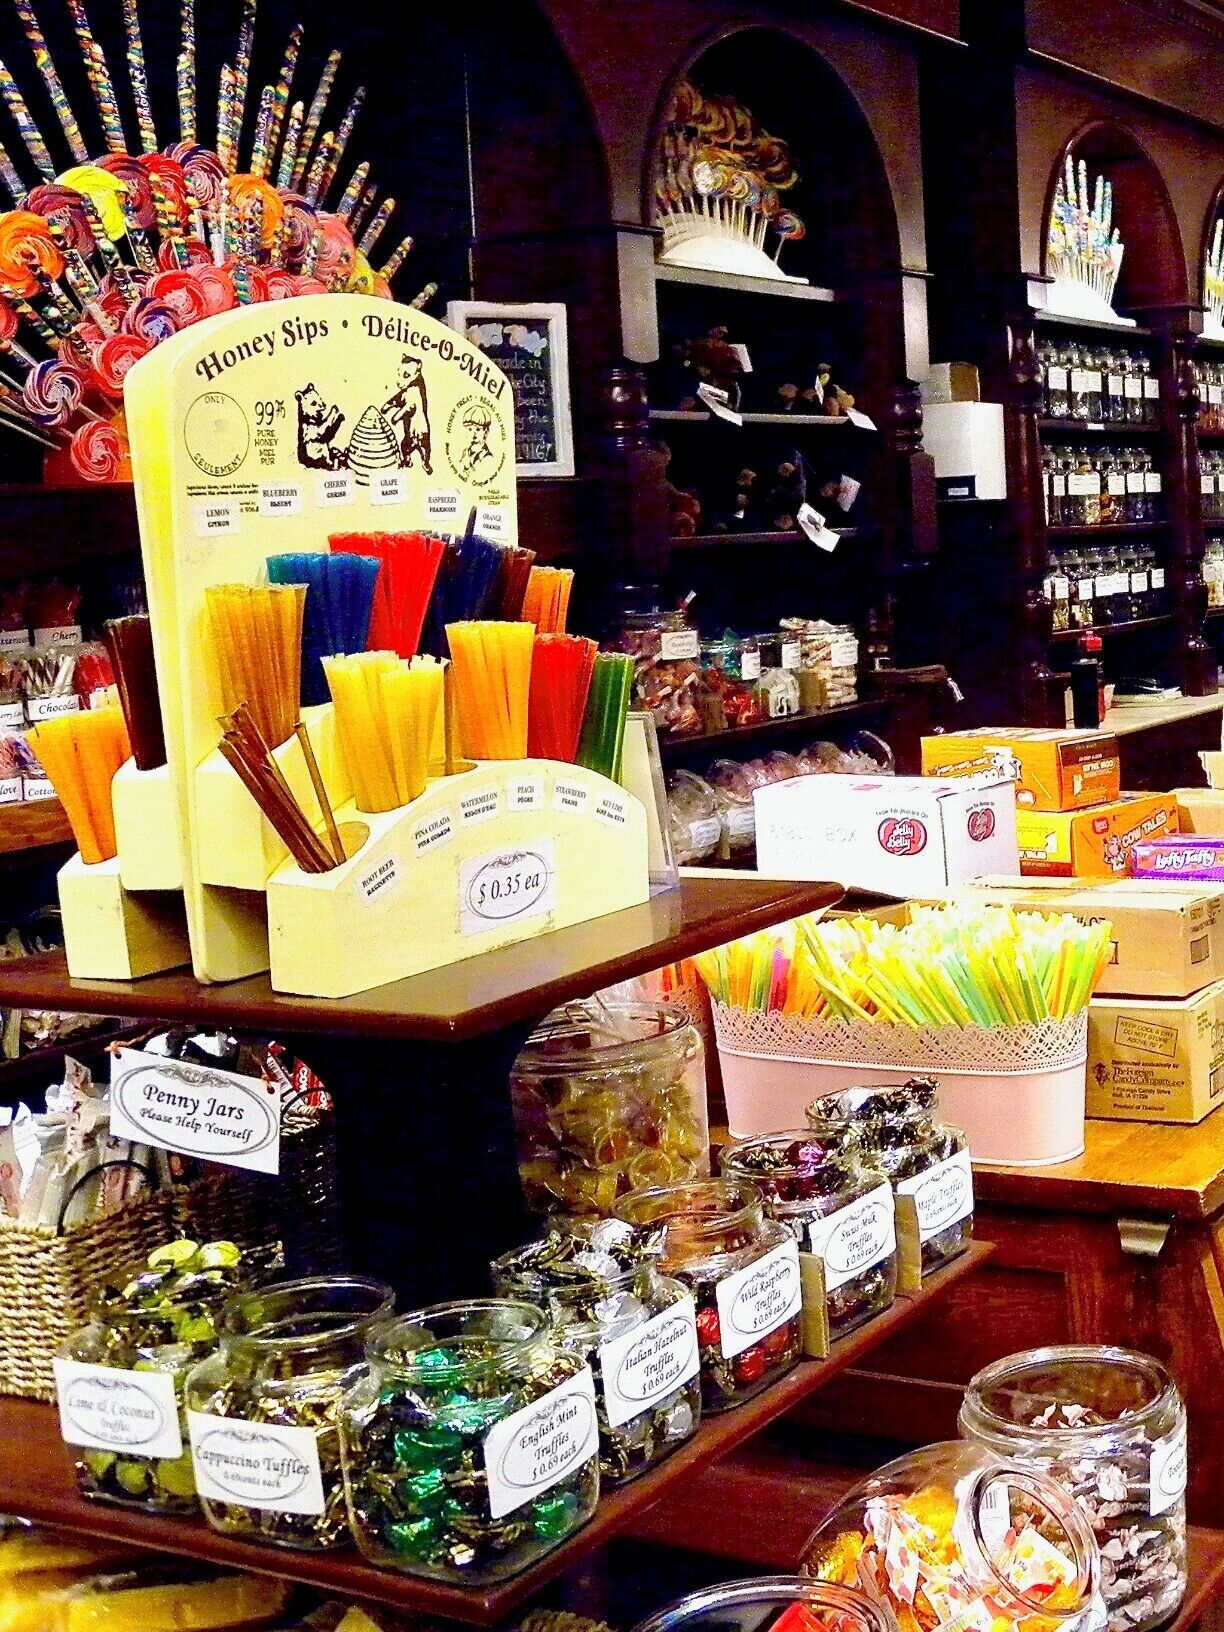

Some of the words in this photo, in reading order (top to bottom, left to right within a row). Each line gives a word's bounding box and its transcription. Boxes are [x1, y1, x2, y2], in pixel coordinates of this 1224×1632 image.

[195, 331, 276, 382] Honey
[282, 316, 330, 348] Sips
[361, 314, 506, 400] Délice-O-Miel
[204, 395, 226, 405] ONLY
[194, 452, 242, 474] SEULEMENT
[261, 457, 275, 465] PUR
[262, 489, 298, 498] BLUEBERRY
[324, 480, 347, 489] CHERRY
[380, 479, 399, 487] GRAPE
[428, 496, 457, 504] RASPBERRY
[206, 508, 230, 518] LEMON
[461, 792, 498, 809] WATERMELON
[518, 786, 534, 794] PEACH
[556, 785, 586, 798] STRAWBERRY
[428, 816, 451, 833] COLADA
[893, 822, 915, 838] Jelly
[1122, 827, 1143, 848] COW
[1142, 810, 1168, 834] TALES
[887, 834, 911, 850] Belly
[1155, 850, 1187, 870] Laffy
[1183, 849, 1216, 868] Taffy
[362, 870, 378, 888] ROOT
[378, 859, 395, 875] BEER
[478, 883, 487, 905] $
[491, 873, 521, 900] 0.35
[524, 872, 540, 889] ea
[143, 1084, 200, 1117] Penny
[203, 1098, 245, 1120] Jars
[140, 1107, 173, 1124] Please
[175, 1114, 202, 1134] Help
[205, 1120, 254, 1144] Yourself
[840, 1223, 861, 1242] Swiss
[861, 1211, 878, 1231] Milk
[847, 1231, 873, 1252] Truffles
[851, 1249, 865, 1266] 0.69
[864, 1243, 878, 1260] each
[740, 1281, 760, 1304] Wild
[759, 1265, 791, 1293] Raspberry
[754, 1289, 782, 1313] Truffles
[758, 1309, 773, 1327] 0.69
[772, 1299, 788, 1317] each
[625, 1347, 653, 1371] Italian
[653, 1324, 688, 1356] Hazelnut
[643, 1351, 675, 1379] Truffles
[648, 1373, 665, 1392] 0.69
[664, 1363, 681, 1382] each
[520, 1421, 555, 1451] English
[556, 1404, 578, 1428] Mint
[534, 1430, 571, 1462] Truffles
[532, 1467, 538, 1482] $
[540, 1455, 560, 1476] 0.69
[559, 1443, 577, 1464] each
